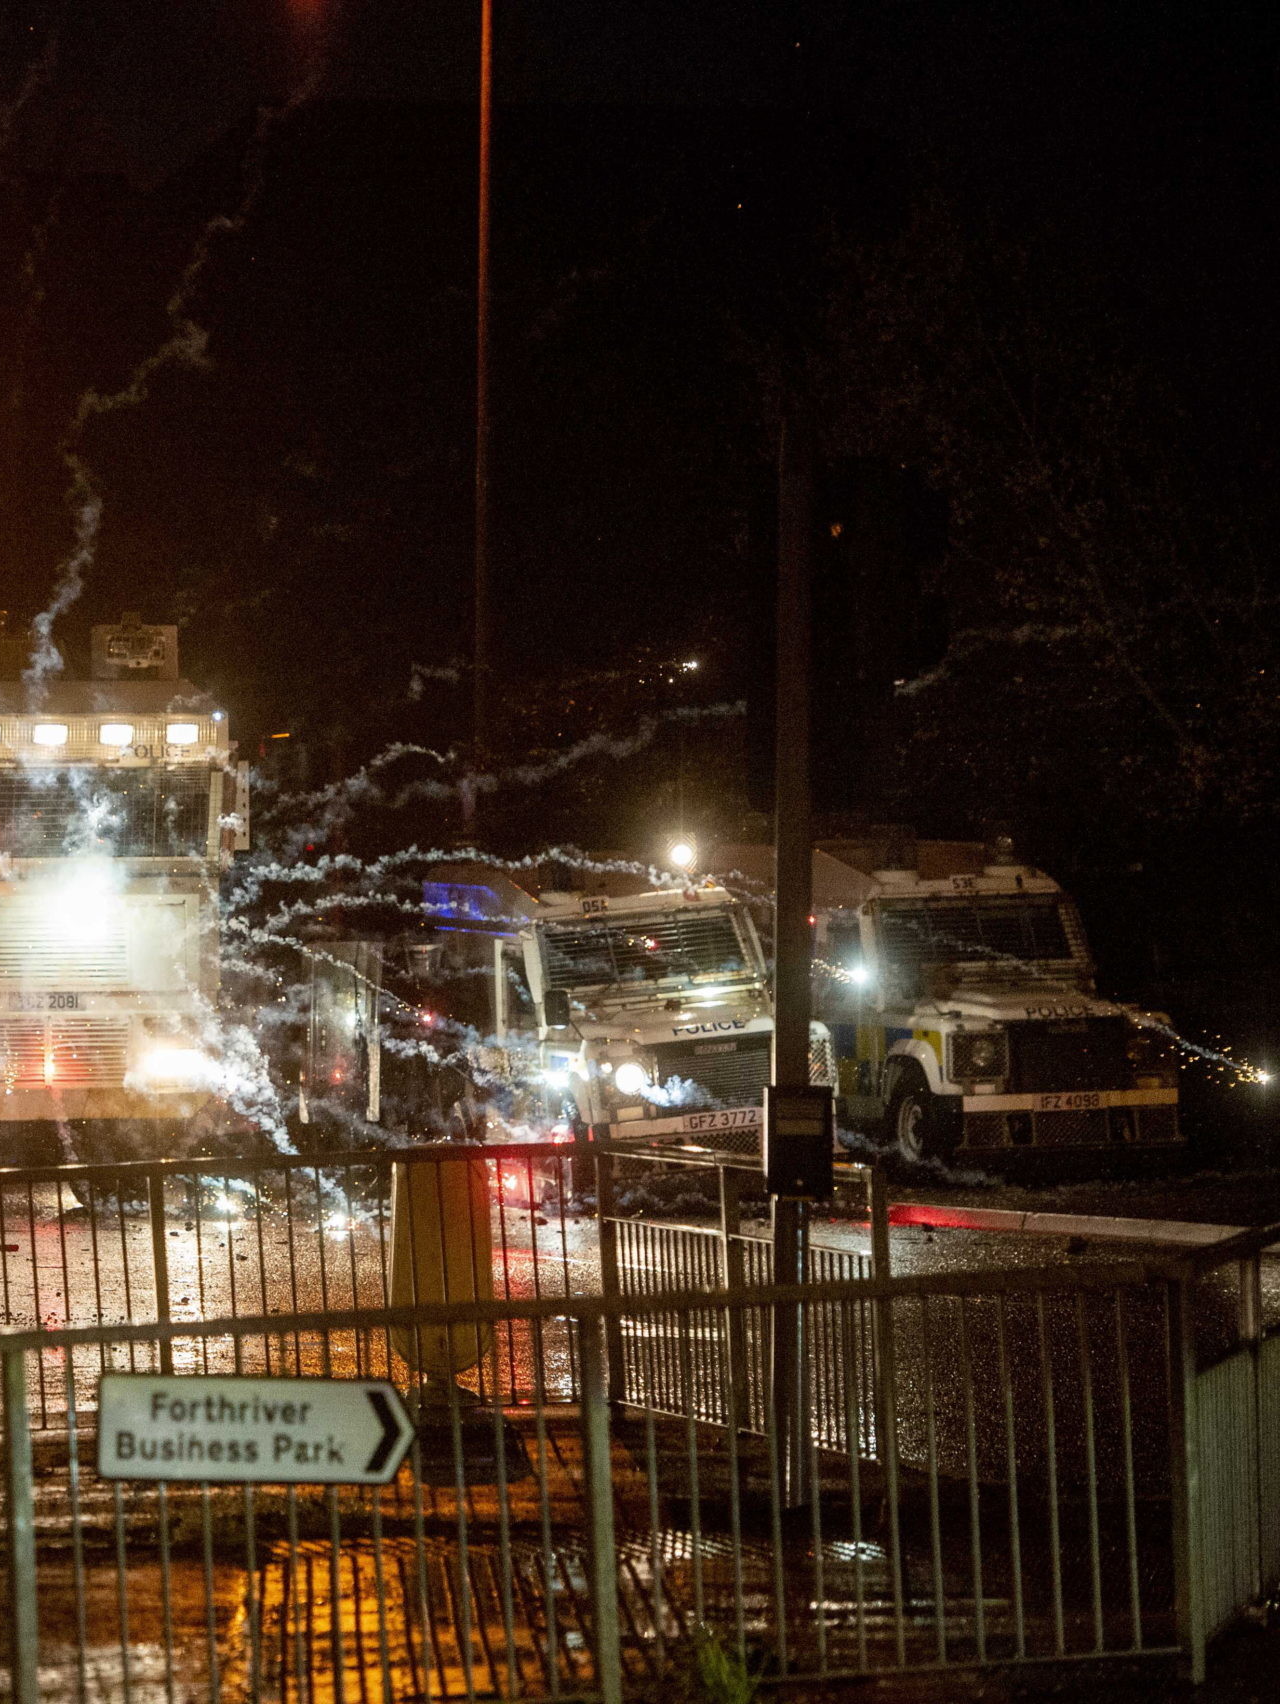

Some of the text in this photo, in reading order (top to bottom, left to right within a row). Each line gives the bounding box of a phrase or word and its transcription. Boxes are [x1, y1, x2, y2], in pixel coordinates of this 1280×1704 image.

[122, 743, 191, 759] OLICE
[1025, 1004, 1095, 1019] POLICE
[689, 1110, 756, 1129] GFZ 3772
[150, 1392, 313, 1425] Forthriver
[115, 1430, 346, 1465] Business Park
